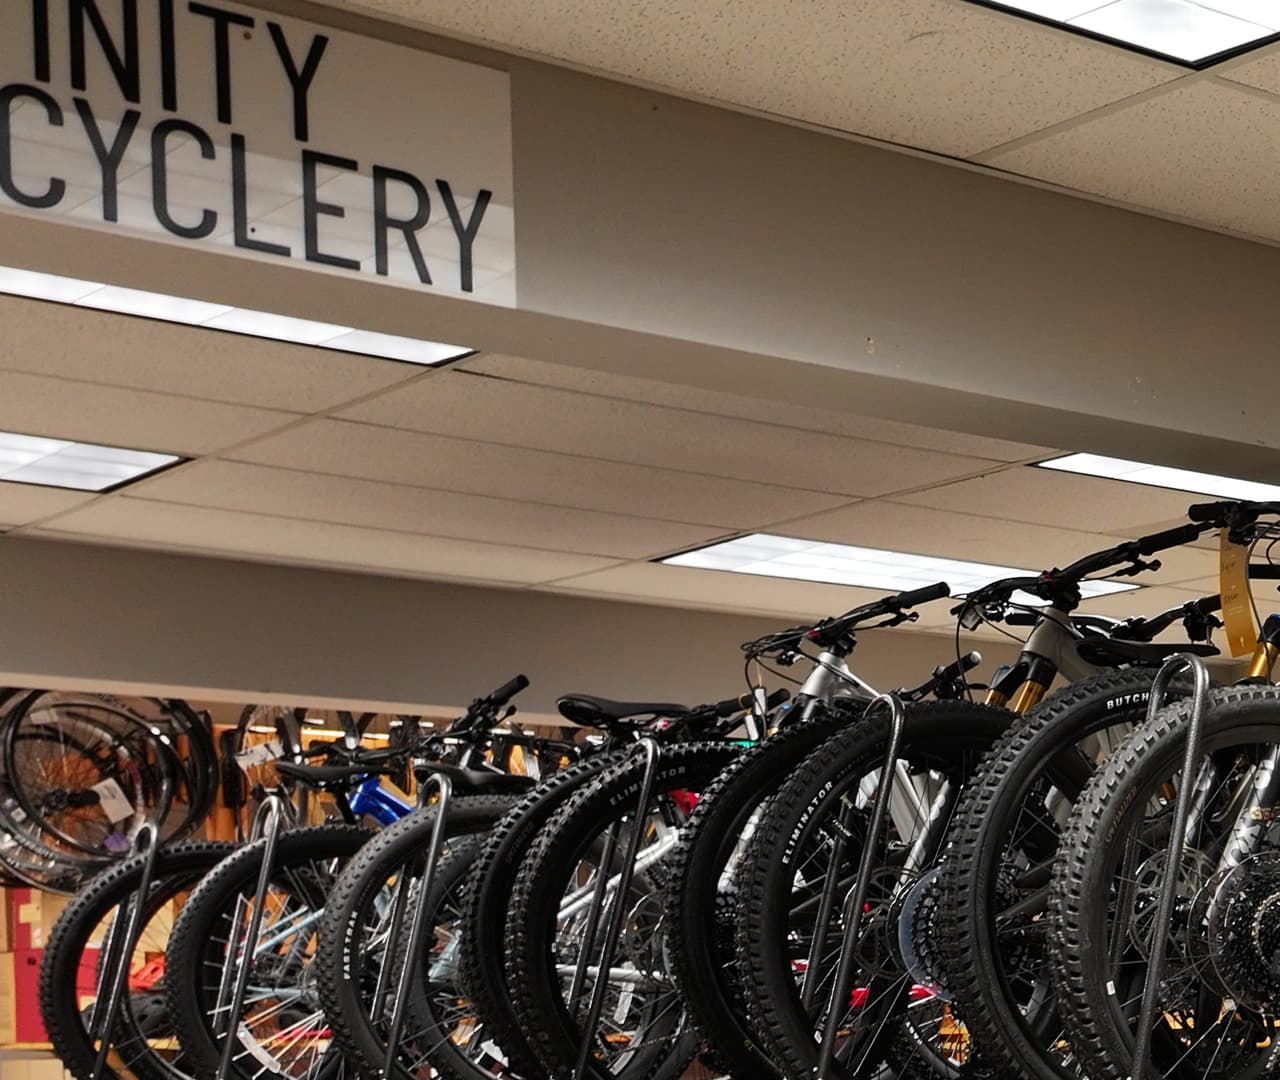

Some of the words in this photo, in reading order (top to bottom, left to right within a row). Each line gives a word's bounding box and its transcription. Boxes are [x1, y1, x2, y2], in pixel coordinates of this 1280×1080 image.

[0, 83, 492, 293] CYCLERY
[609, 765, 686, 806] ELIMTOR
[781, 780, 834, 865] ELIMINATOR
